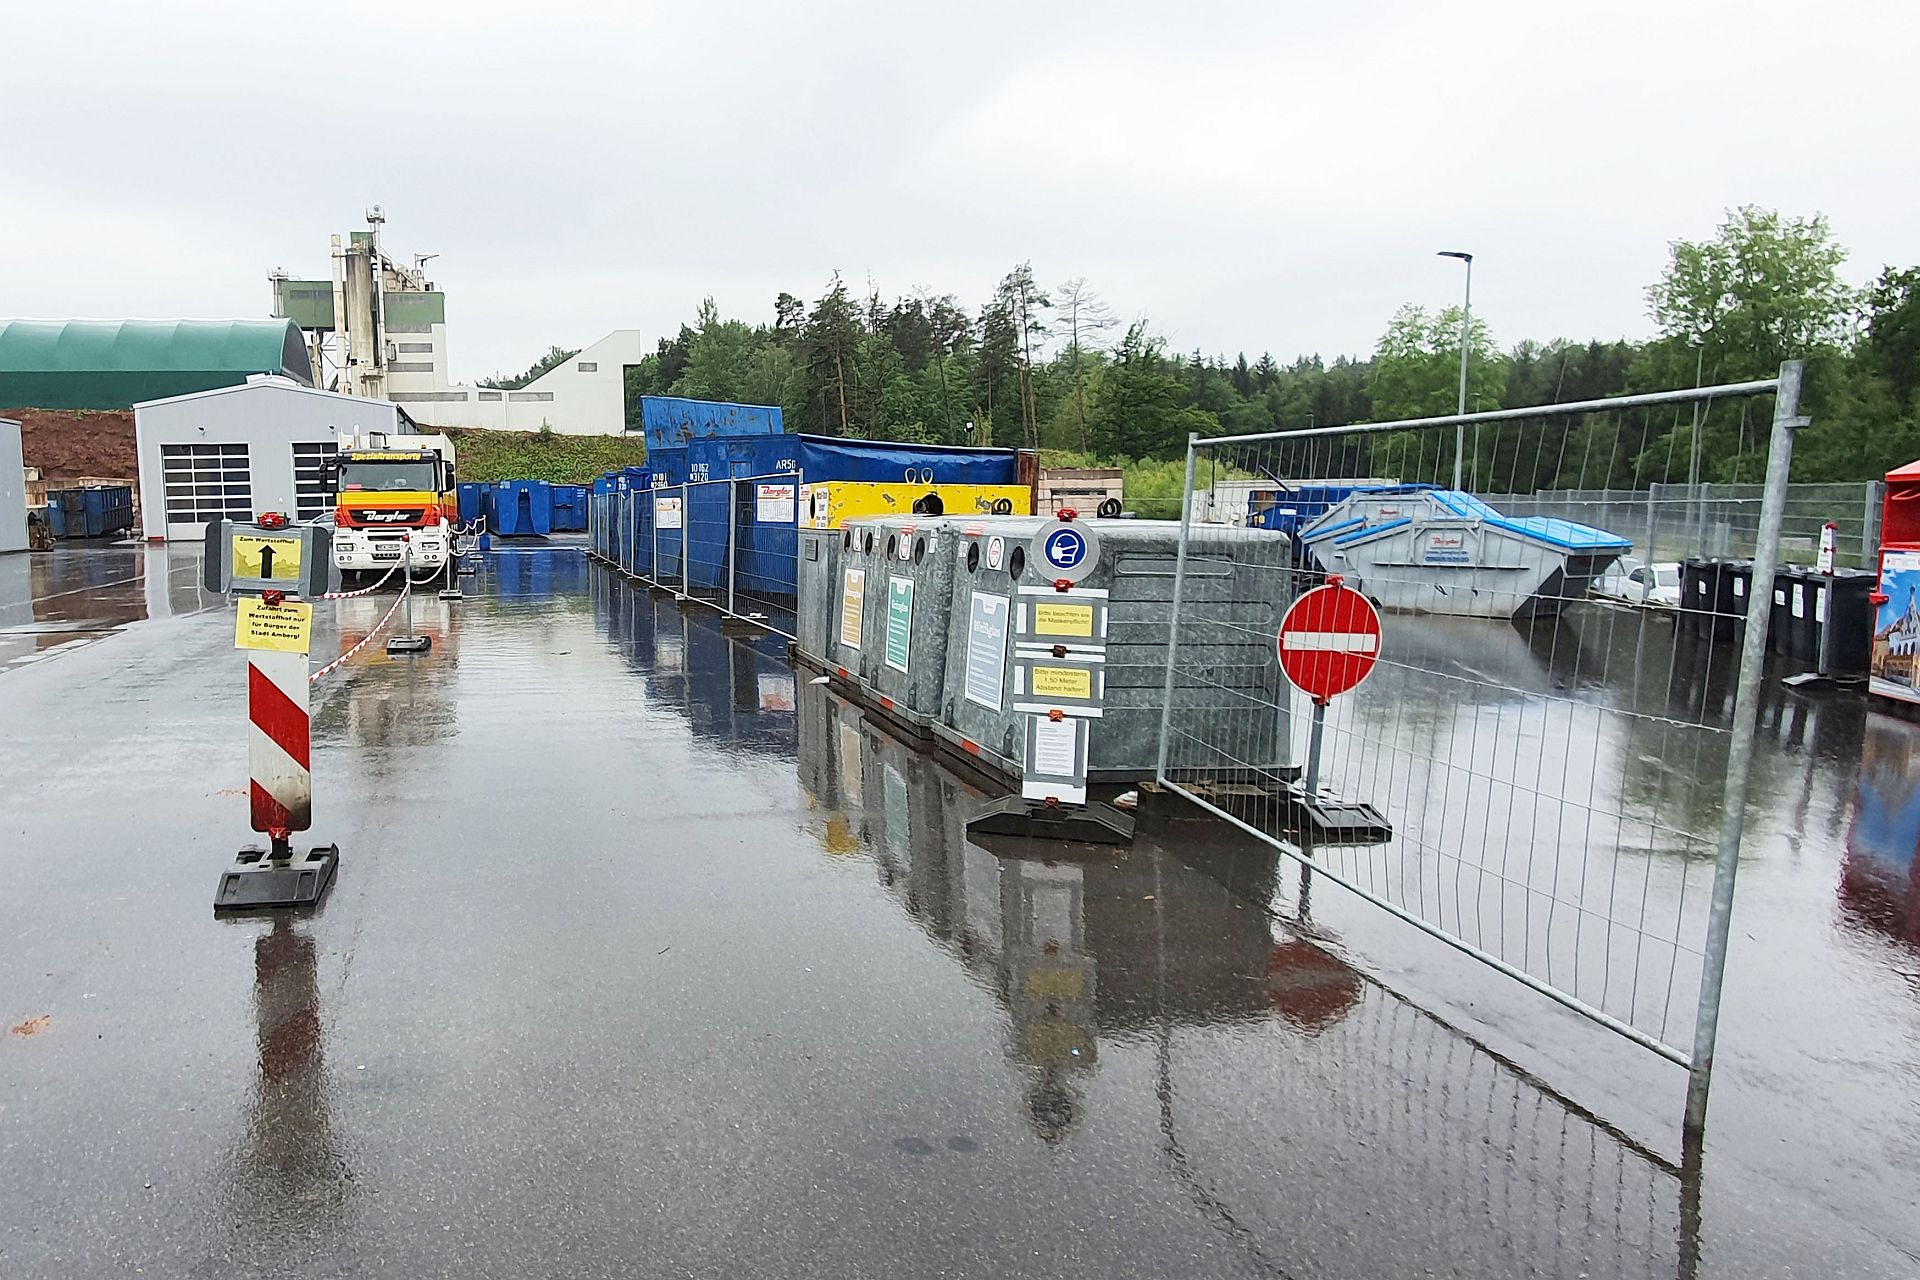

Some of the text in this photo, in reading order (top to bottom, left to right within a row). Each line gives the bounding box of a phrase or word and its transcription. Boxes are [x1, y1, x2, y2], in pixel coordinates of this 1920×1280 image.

[363, 510, 410, 522] Bergler
[249, 613, 291, 621] Wertstoffhof
[264, 622, 286, 630] Bürger
